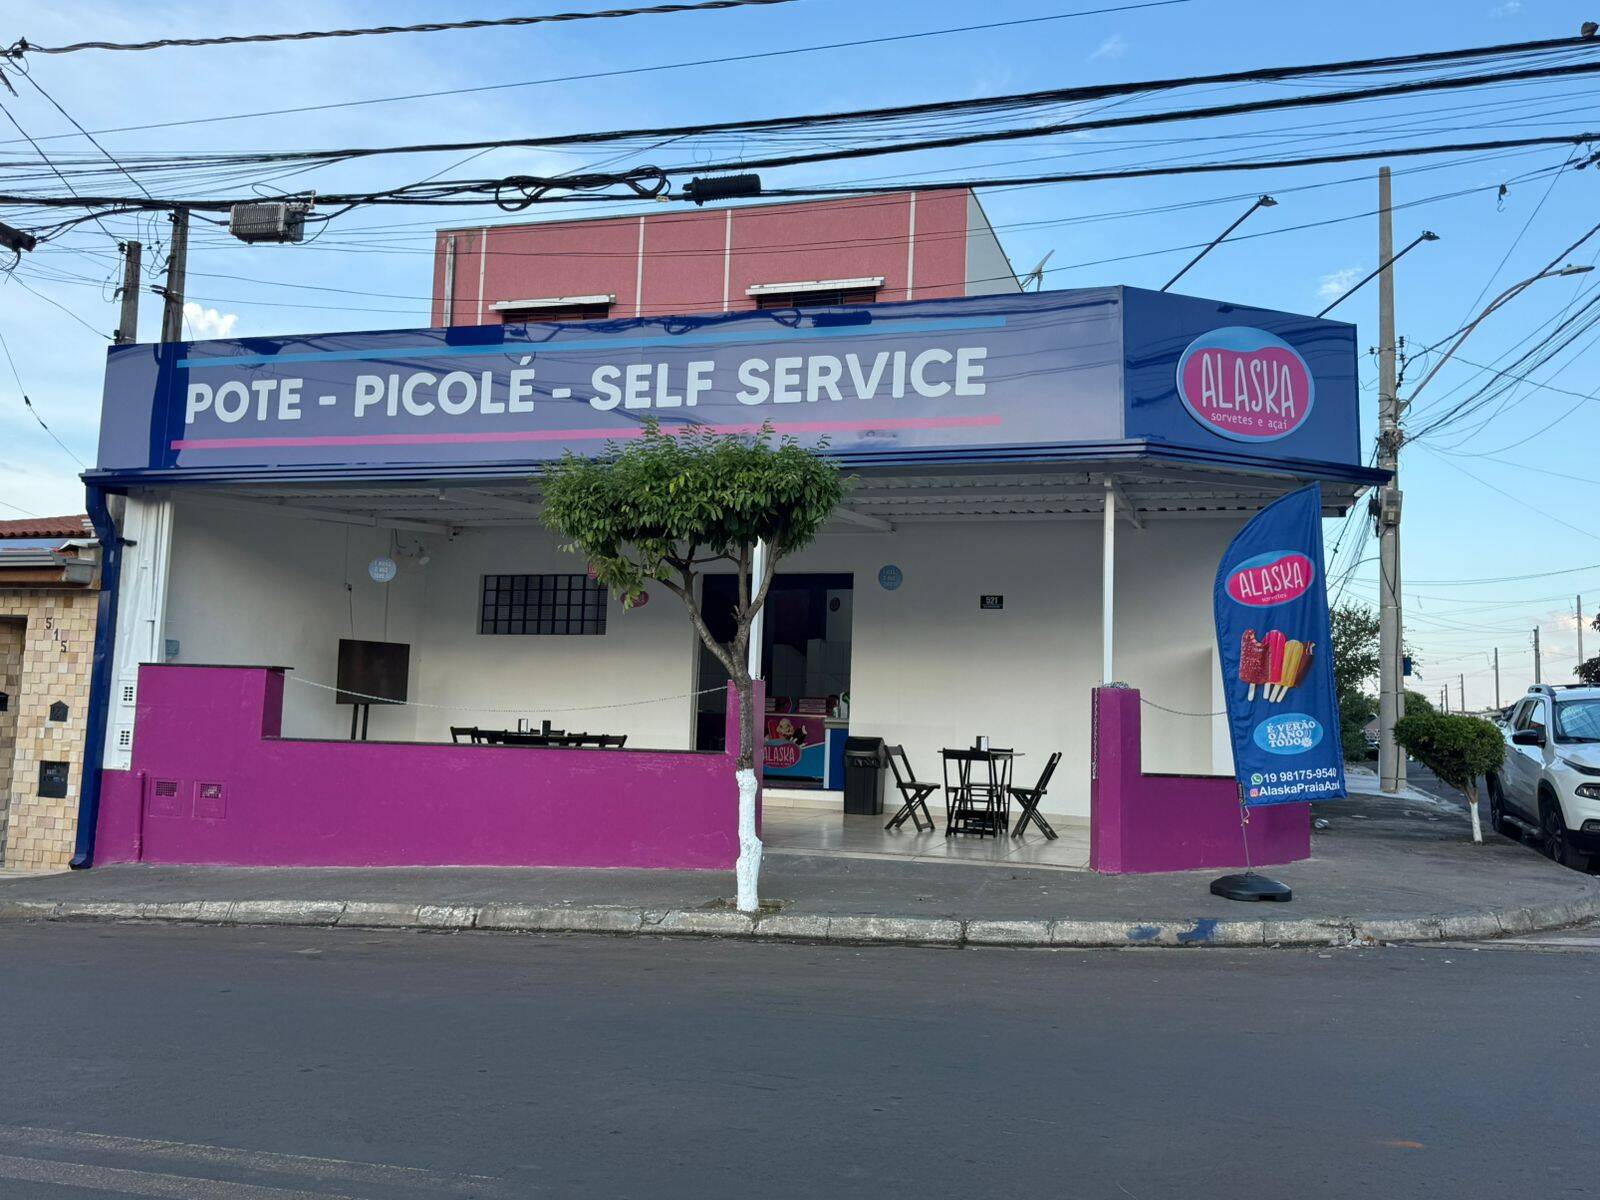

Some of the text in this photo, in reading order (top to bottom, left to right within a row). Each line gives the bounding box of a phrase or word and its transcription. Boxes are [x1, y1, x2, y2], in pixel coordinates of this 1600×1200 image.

[185, 347, 988, 424] POTE - PICOLÉ - SELF SERVICE
[1202, 353, 1295, 418] ALASKA
[1210, 411, 1253, 426] sorvetes
[1257, 418, 1264, 428] e
[1239, 562, 1304, 598] ALASKA
[1276, 720, 1316, 732] VERÃO
[1269, 738, 1302, 748] TODO
[1263, 767, 1337, 783] 19 98175-9540
